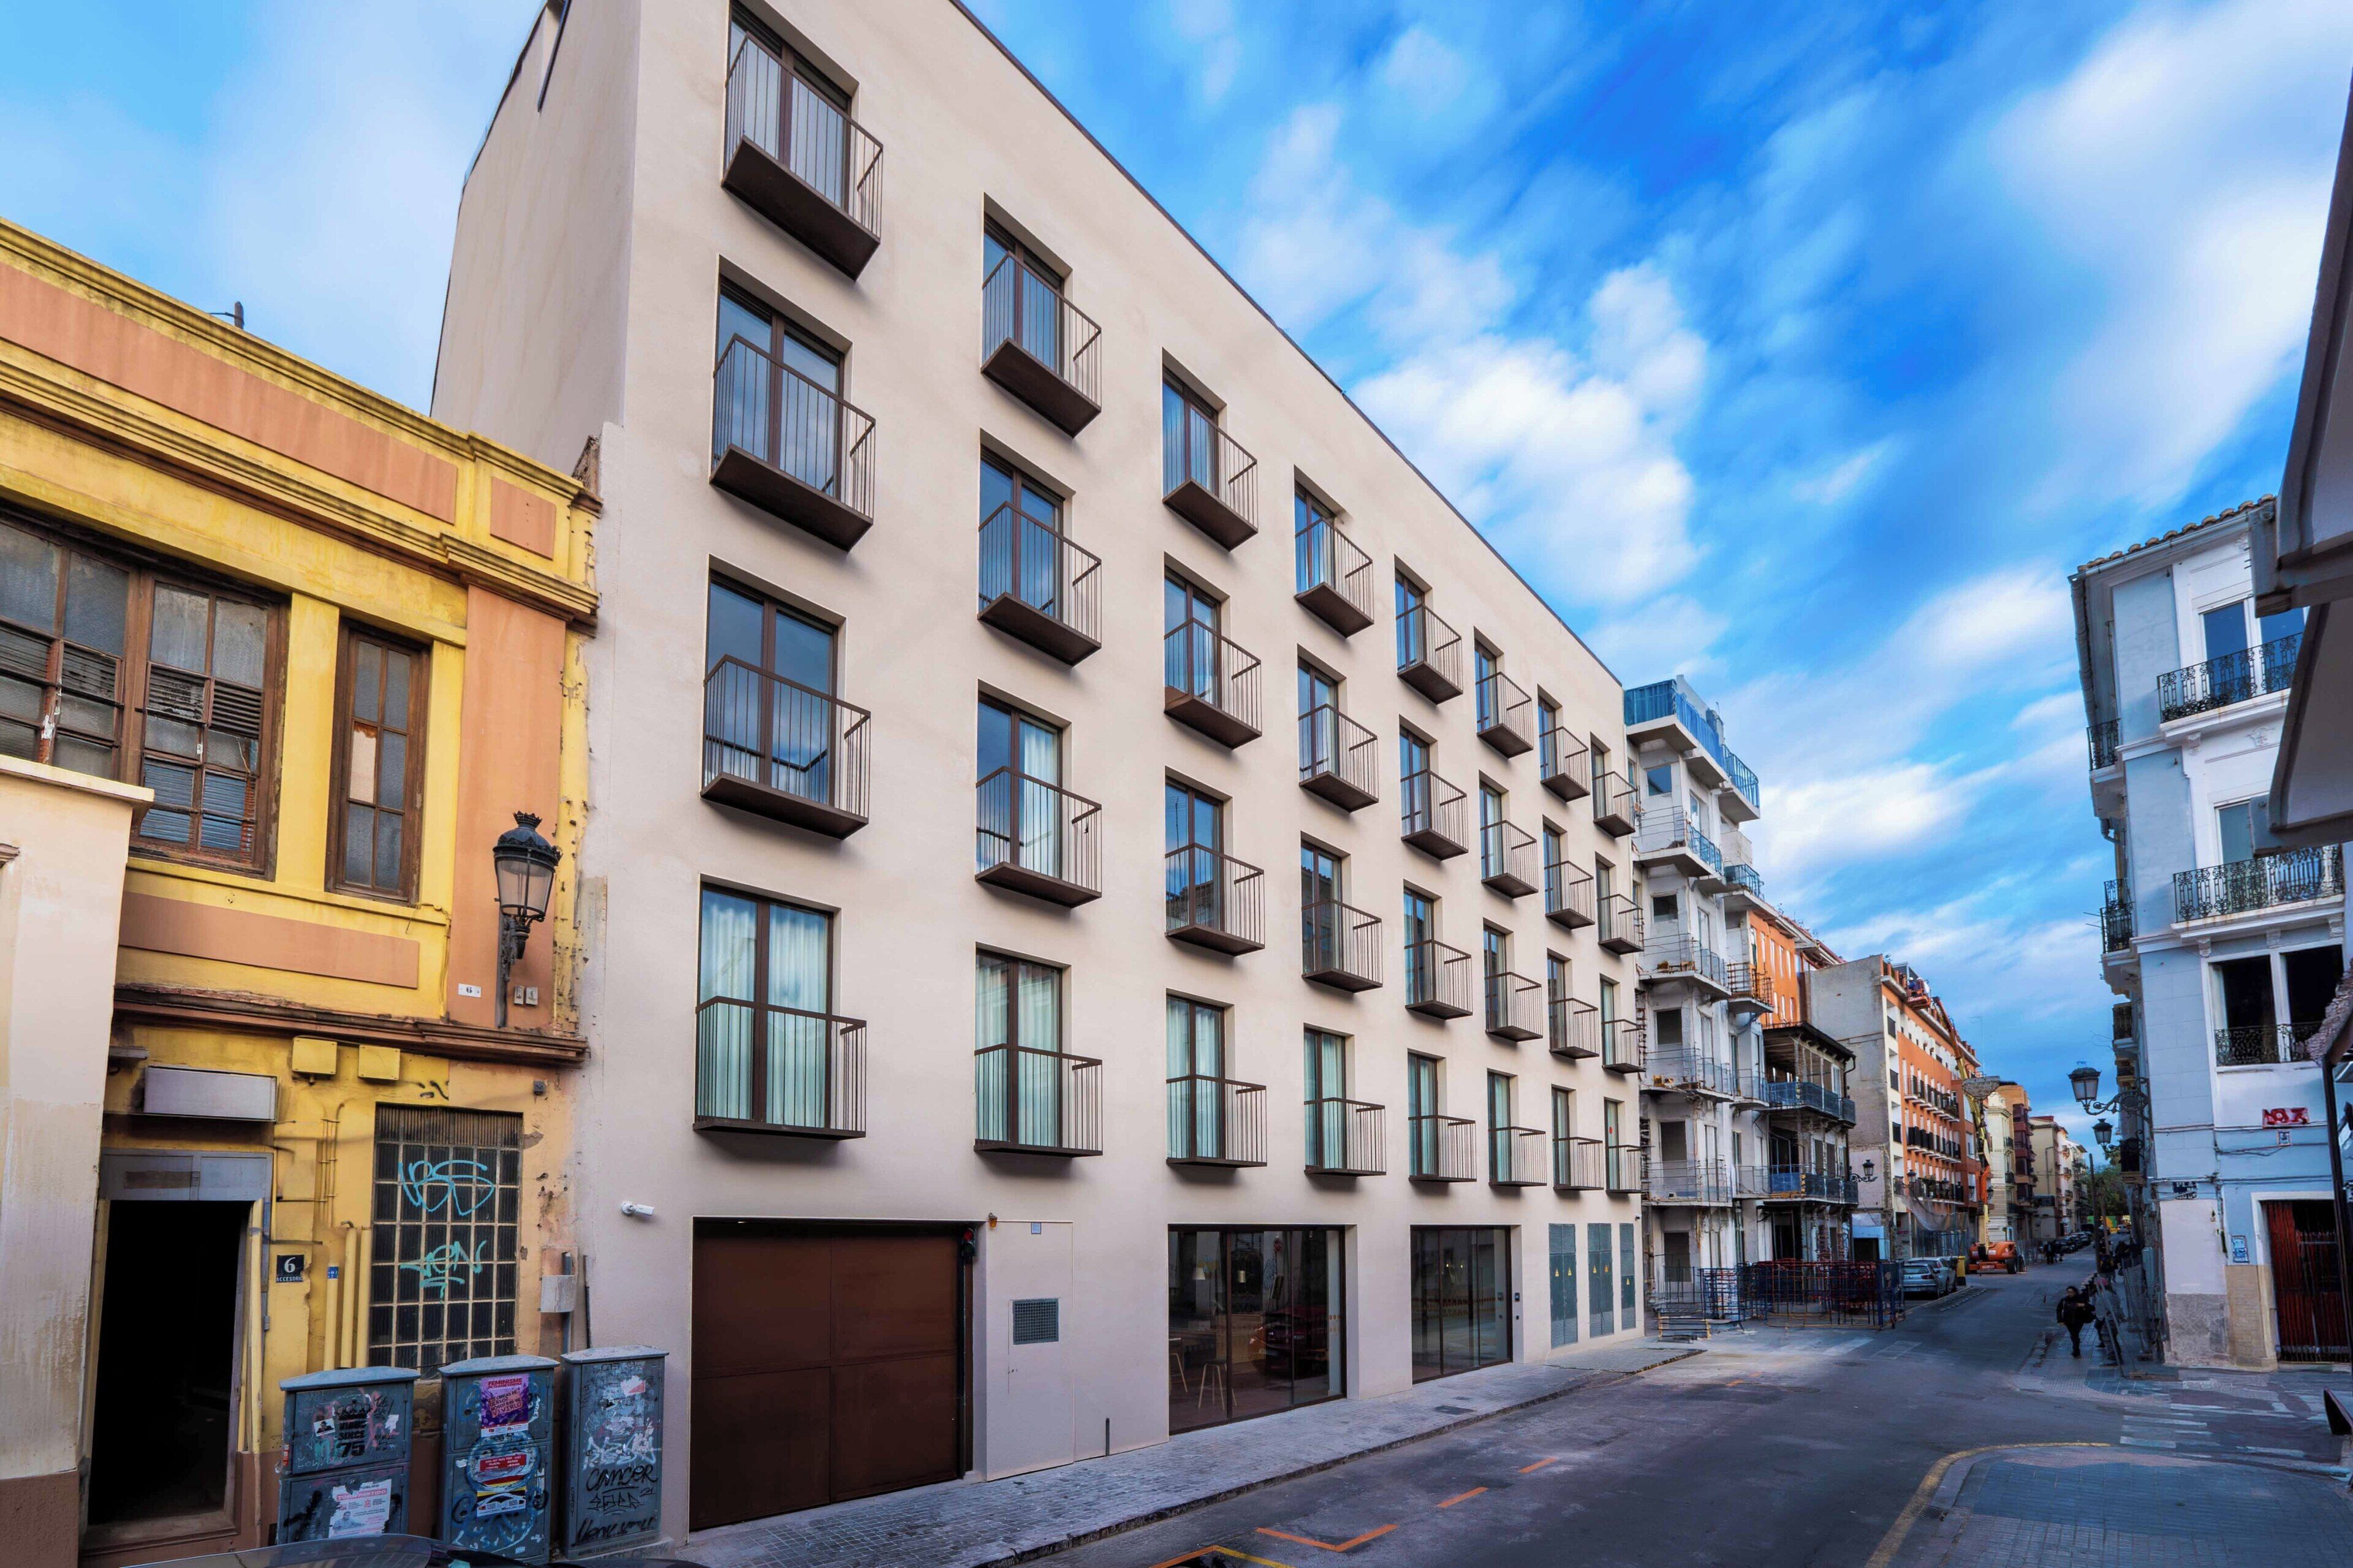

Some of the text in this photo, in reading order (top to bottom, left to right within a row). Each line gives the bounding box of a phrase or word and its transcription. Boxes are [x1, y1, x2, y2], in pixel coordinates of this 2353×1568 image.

[284, 1257, 295, 1273] 6
[493, 1401, 522, 1415] VIVIRLO
[338, 1430, 365, 1441] SINCE
[336, 1441, 365, 1458] 75
[358, 1489, 387, 1498] PARTIDO
